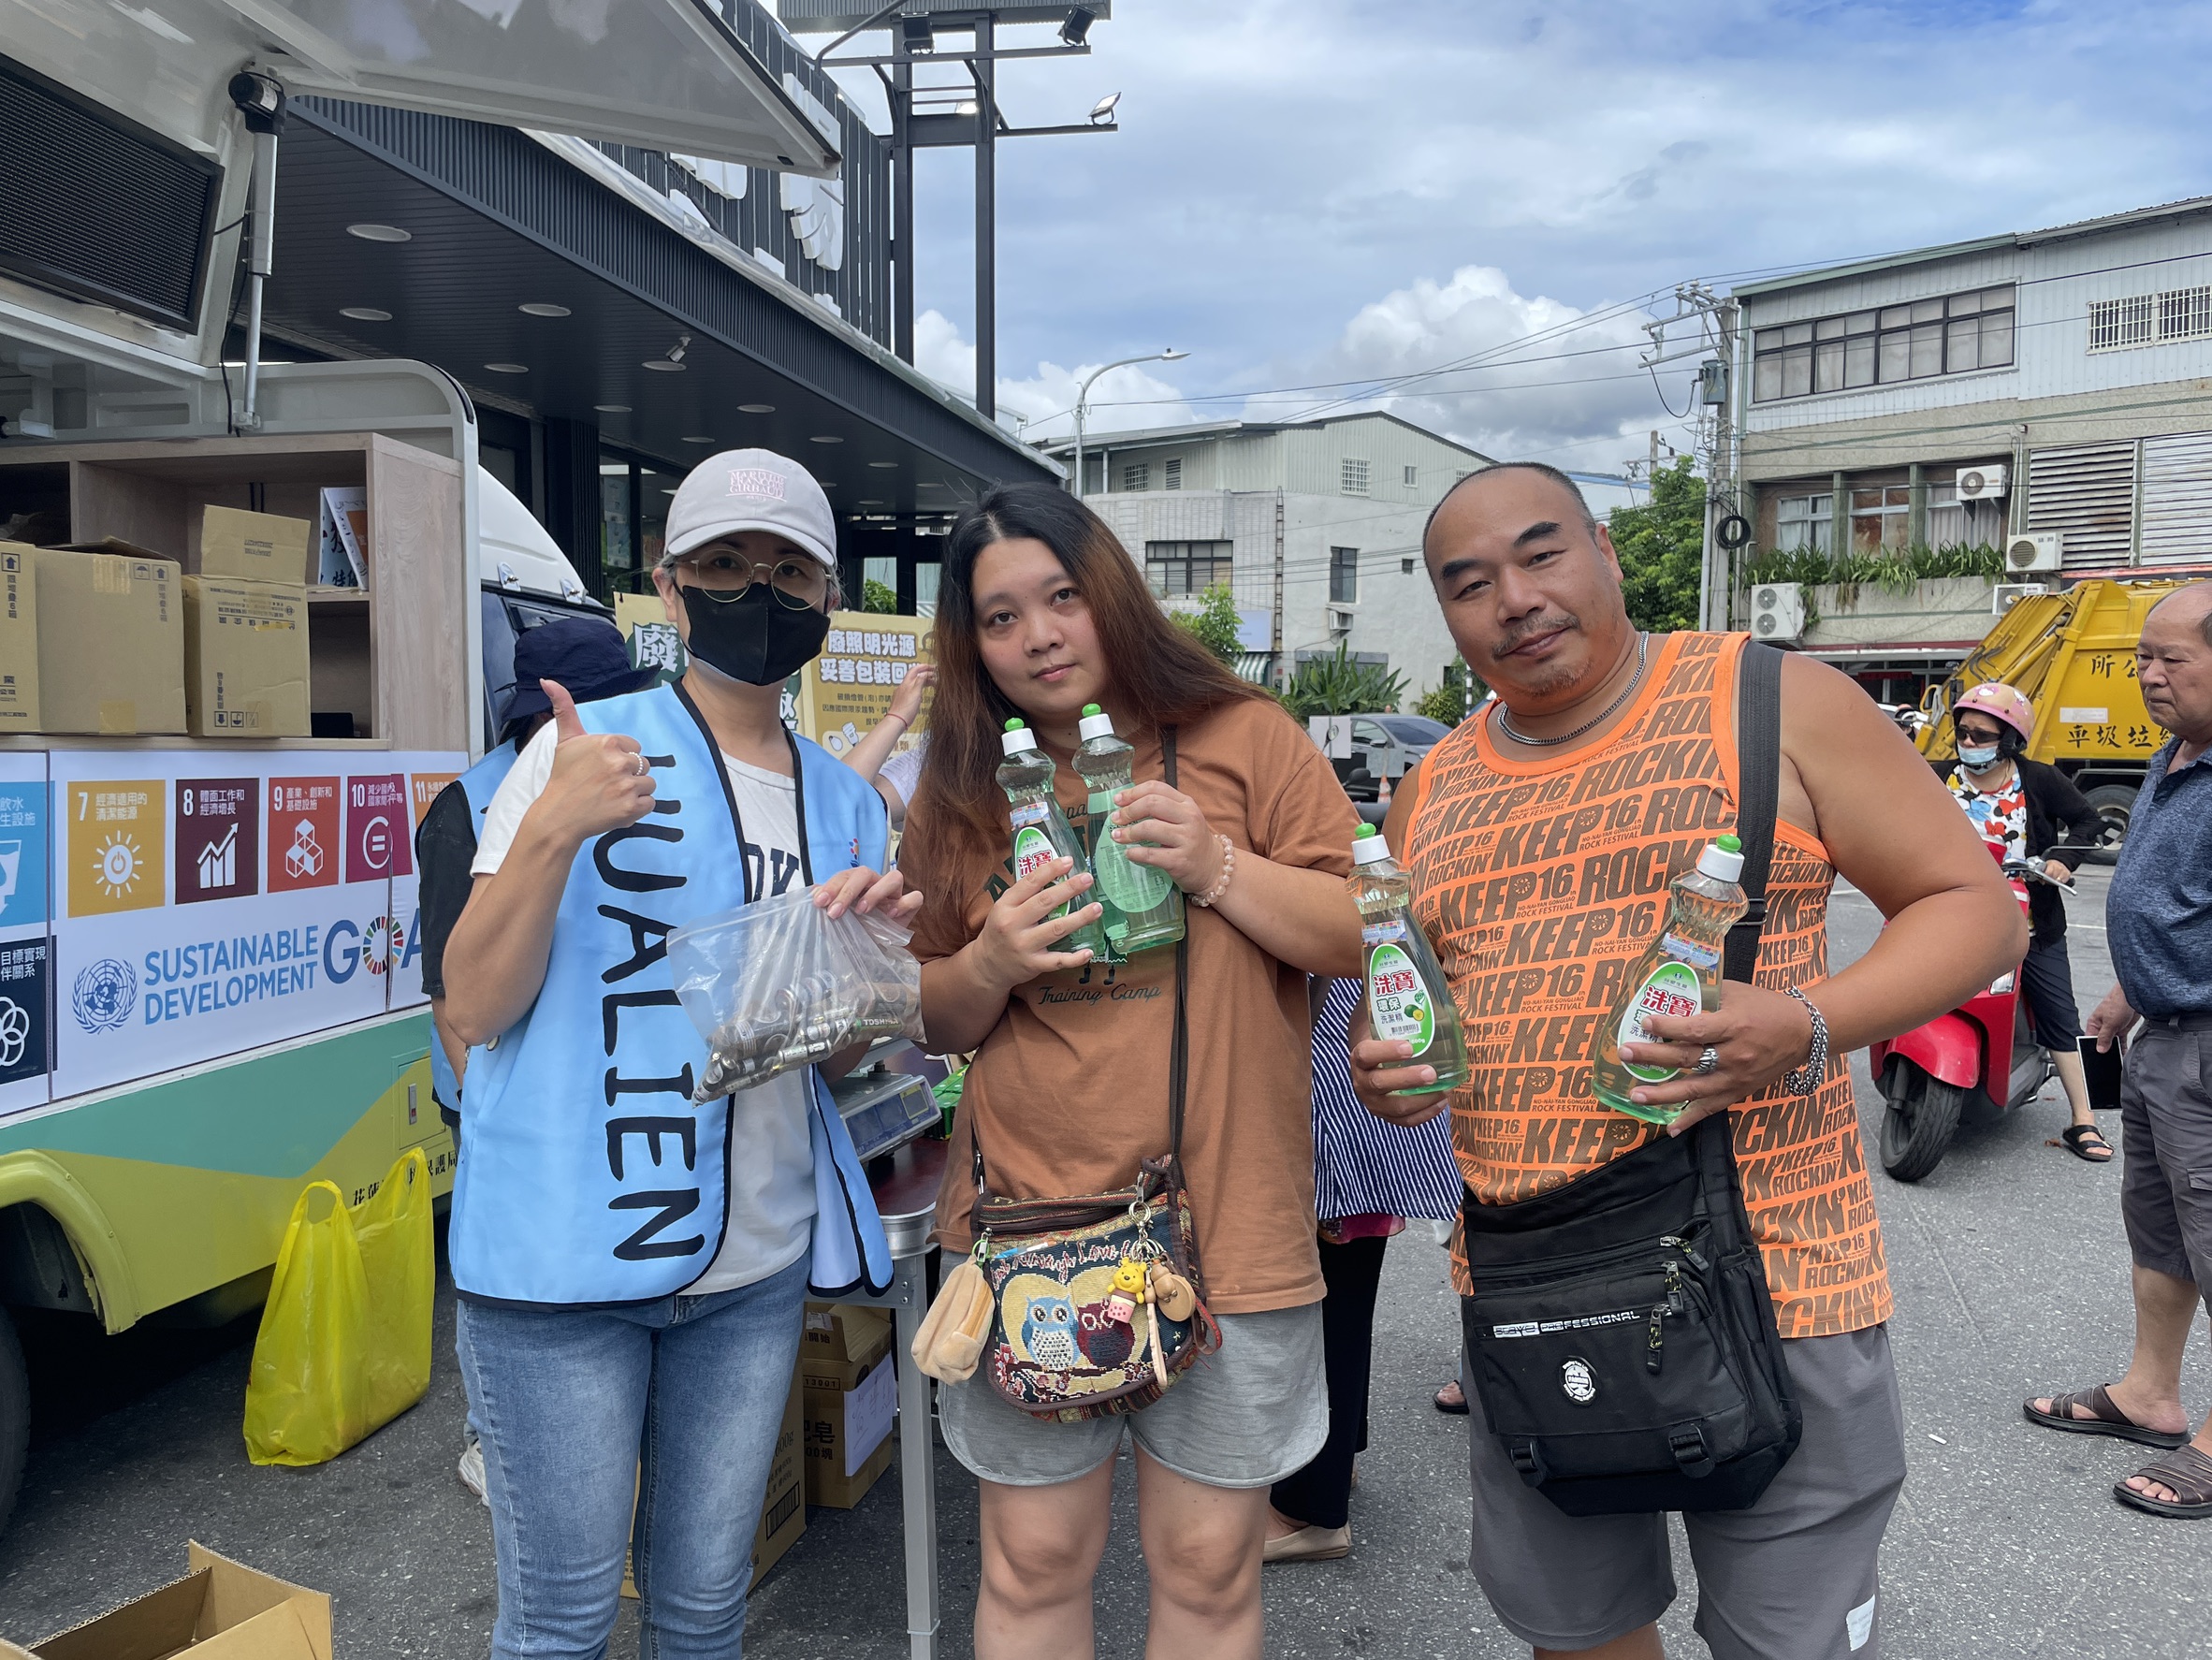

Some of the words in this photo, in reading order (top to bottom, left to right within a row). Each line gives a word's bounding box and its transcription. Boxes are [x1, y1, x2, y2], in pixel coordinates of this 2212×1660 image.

[729, 484, 784, 498] GIRBAUD
[827, 630, 916, 657] 廢照明光源
[820, 657, 921, 685] 妥善包裝回
[95, 793, 147, 807] 經濟適用的
[199, 789, 245, 803] 體面工作和
[273, 786, 283, 811] 9
[286, 786, 332, 799] 產業、創新和
[352, 783, 365, 808] 10
[415, 780, 427, 802] 11
[79, 792, 88, 821] 7
[183, 789, 194, 817] 8
[199, 802, 236, 816] 經濟增長
[286, 799, 317, 812] 基礎設施
[1433, 782, 1539, 843] KEEP
[1534, 773, 1576, 805] 16
[95, 806, 138, 822] 清潔能源
[1475, 830, 1495, 848] 16
[1489, 804, 1605, 872] KEEP
[1603, 794, 1643, 832] 16
[1579, 841, 1601, 852] ROCK
[1602, 832, 1639, 846] FESTIVAL
[1440, 871, 1537, 935] KEEP
[1537, 863, 1576, 901] 16
[1516, 909, 1537, 919] ROCK
[1538, 902, 1574, 916] FESTIVAL
[1488, 925, 1506, 942] 16
[1502, 907, 1616, 968] KEEP
[1617, 900, 1656, 939] 16
[144, 925, 319, 987] SUSTAINABLE
[1592, 944, 1616, 955] ROCK
[1761, 938, 1797, 967] KEEP
[1797, 935, 1809, 953] 16
[1372, 968, 1417, 997] 洗寶
[1462, 967, 1547, 1020] KEEP
[1547, 963, 1586, 997] 16
[144, 961, 318, 1027] DEVELOPMENT
[1038, 985, 1103, 1006] Training
[1110, 983, 1161, 1003] Camp
[1639, 983, 1697, 1018] 洗寶
[1376, 997, 1402, 1013] 環保
[1521, 1004, 1542, 1013] ROCK
[1544, 1002, 1582, 1012] FESTIVAL
[1492, 1020, 1511, 1036] 16
[1472, 1066, 1556, 1112] KEEP
[1557, 1065, 1594, 1098] 16
[1556, 1104, 1595, 1113] FESTIVAL
[1504, 1118, 1521, 1134] 16
[1521, 1117, 1640, 1163] KEEP
[1824, 1136, 1838, 1154] 16
[1852, 1231, 1865, 1250] 16
[1540, 1311, 1640, 1332] PROFESSIONAL
[805, 1332, 831, 1344] 開始
